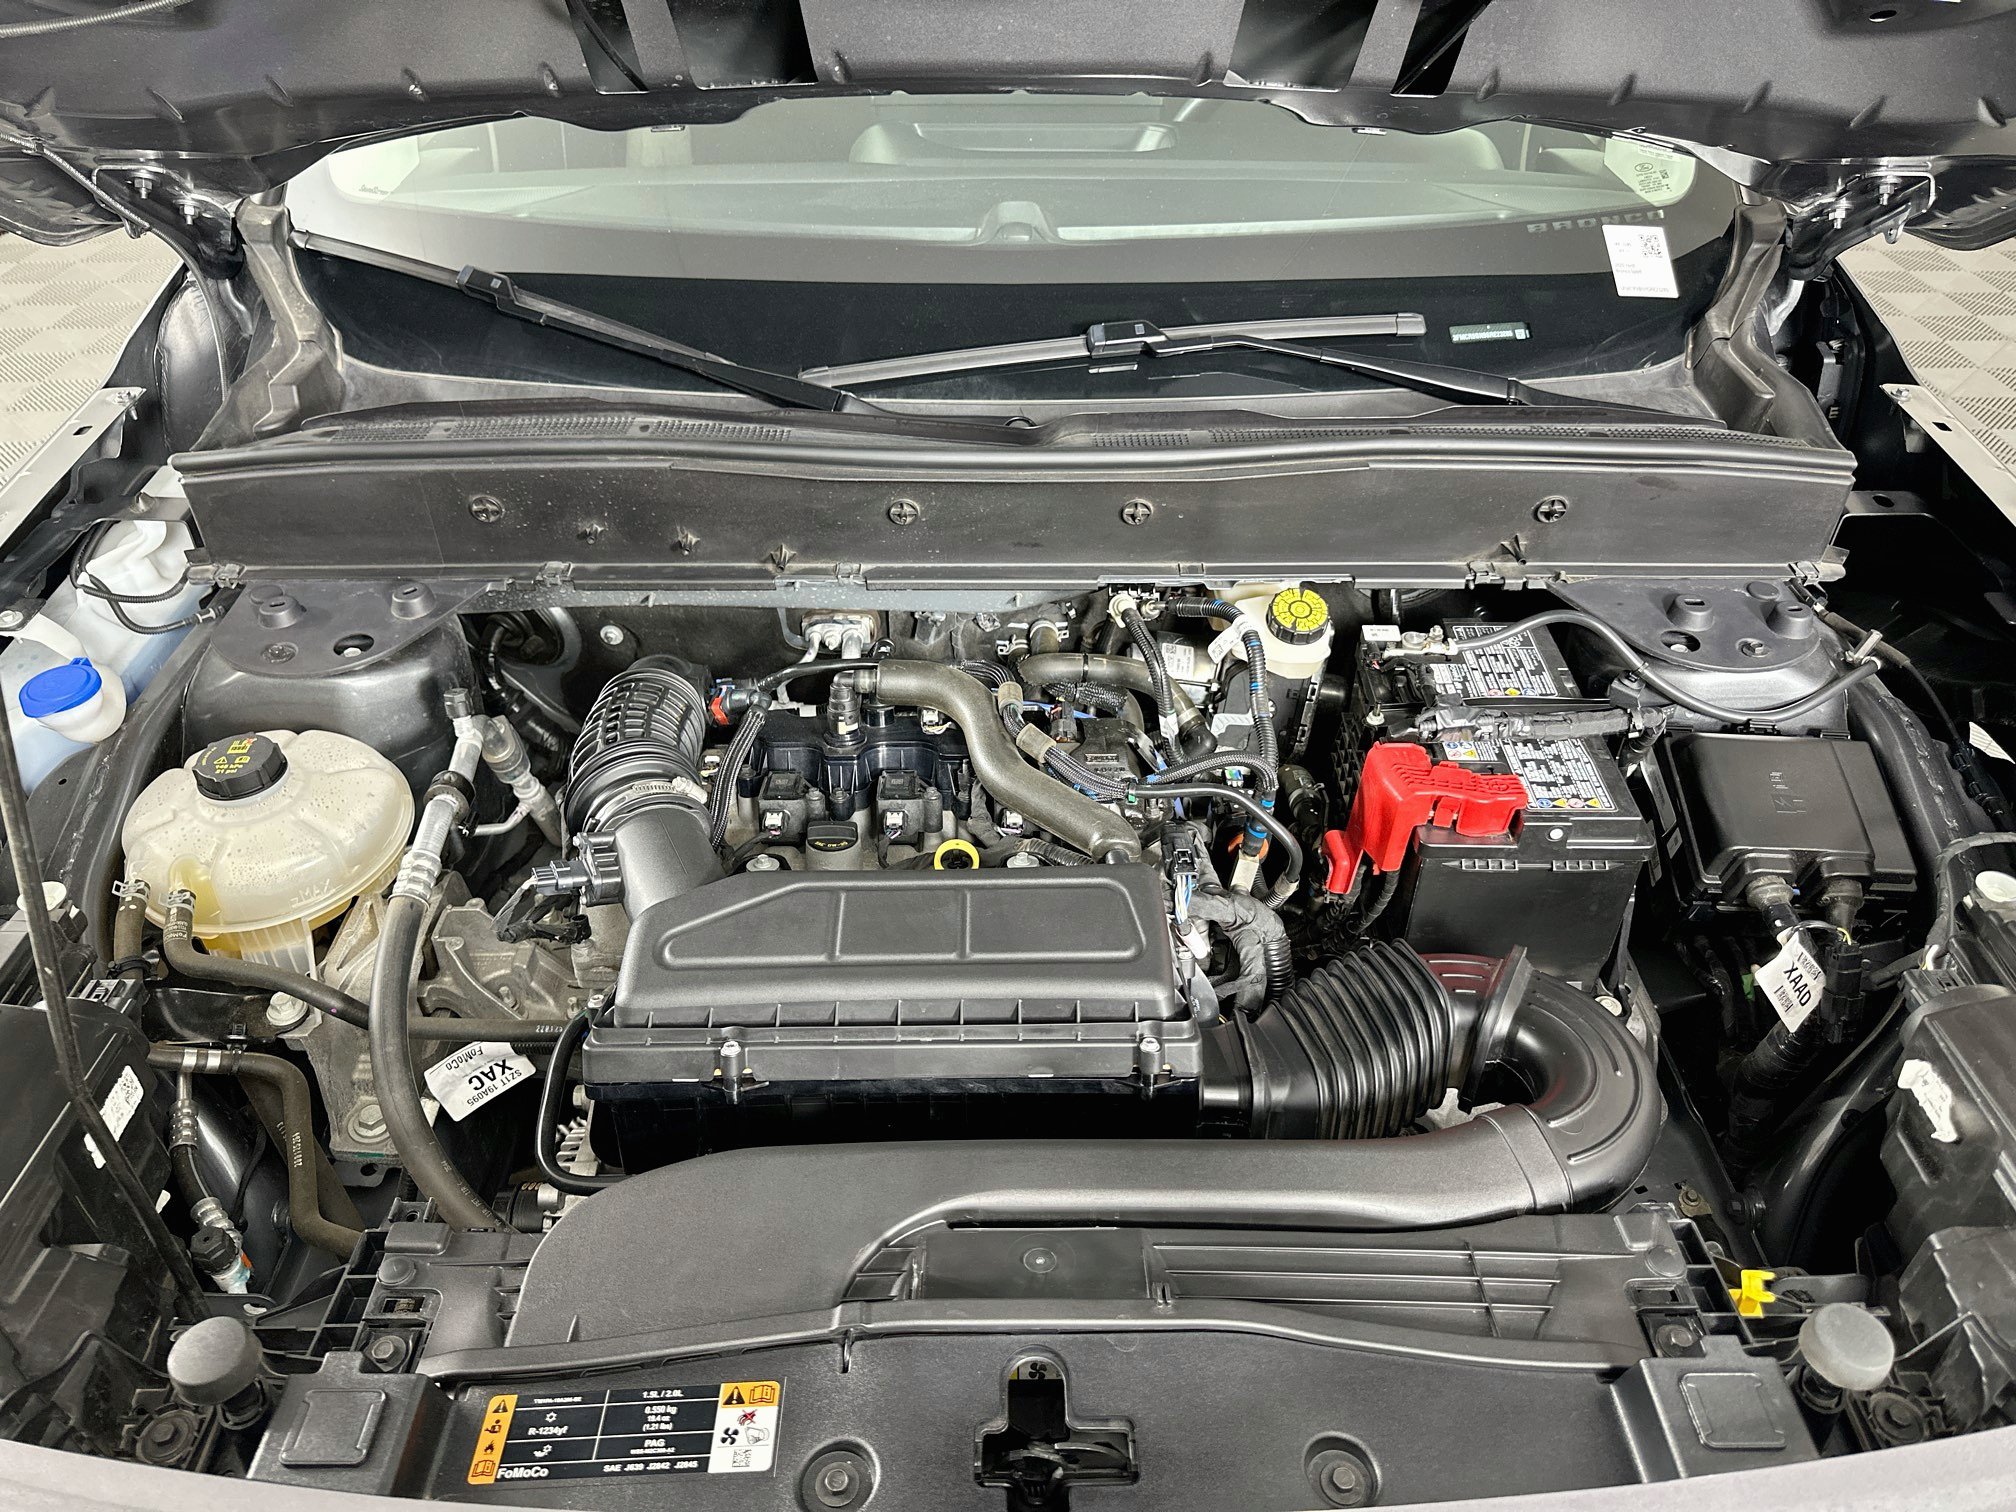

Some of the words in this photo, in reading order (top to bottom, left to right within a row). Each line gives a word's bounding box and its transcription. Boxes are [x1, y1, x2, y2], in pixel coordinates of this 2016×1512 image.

[1526, 209, 1664, 233] BRONCO
[1783, 960, 1812, 1007] XAAD
[445, 1046, 484, 1071] FoMoCo
[468, 1058, 514, 1091] XAC
[466, 1083, 499, 1106] 19A095
[642, 1391, 660, 1399] 1.5L
[644, 1405, 666, 1414] 0.550
[666, 1405, 678, 1415] kg
[528, 1425, 569, 1436] R-1234yf
[644, 1438, 666, 1448] PAG
[496, 1466, 550, 1479] FoMoCo
[603, 1464, 622, 1473] SAE
